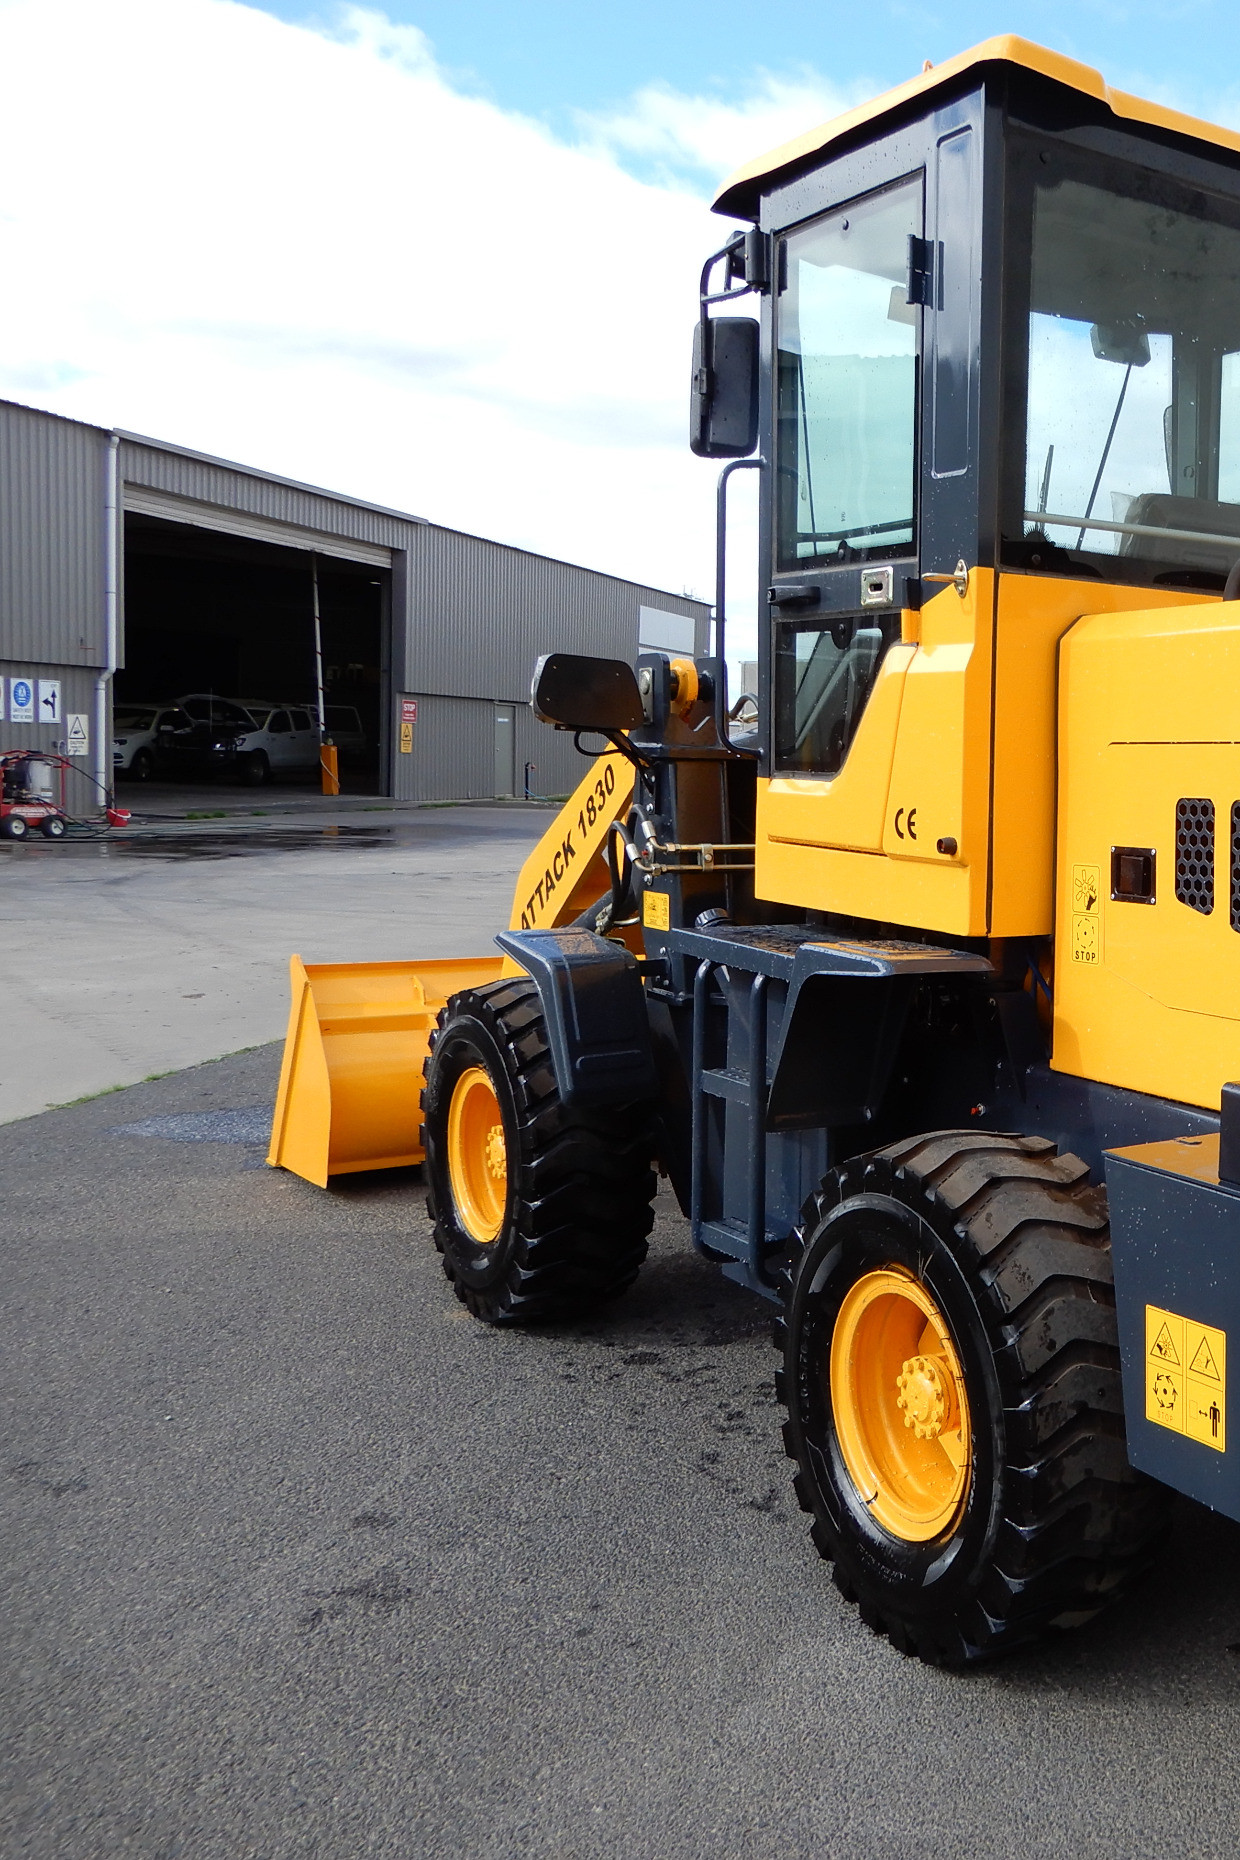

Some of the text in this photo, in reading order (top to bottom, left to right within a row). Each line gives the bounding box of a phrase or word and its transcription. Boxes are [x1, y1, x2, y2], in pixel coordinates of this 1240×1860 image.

[403, 703, 416, 711] STOP
[894, 807, 917, 840] CE
[521, 763, 615, 930] ATTACK 1830
[1075, 950, 1096, 962] STOP
[1157, 1410, 1173, 1422] STOP
